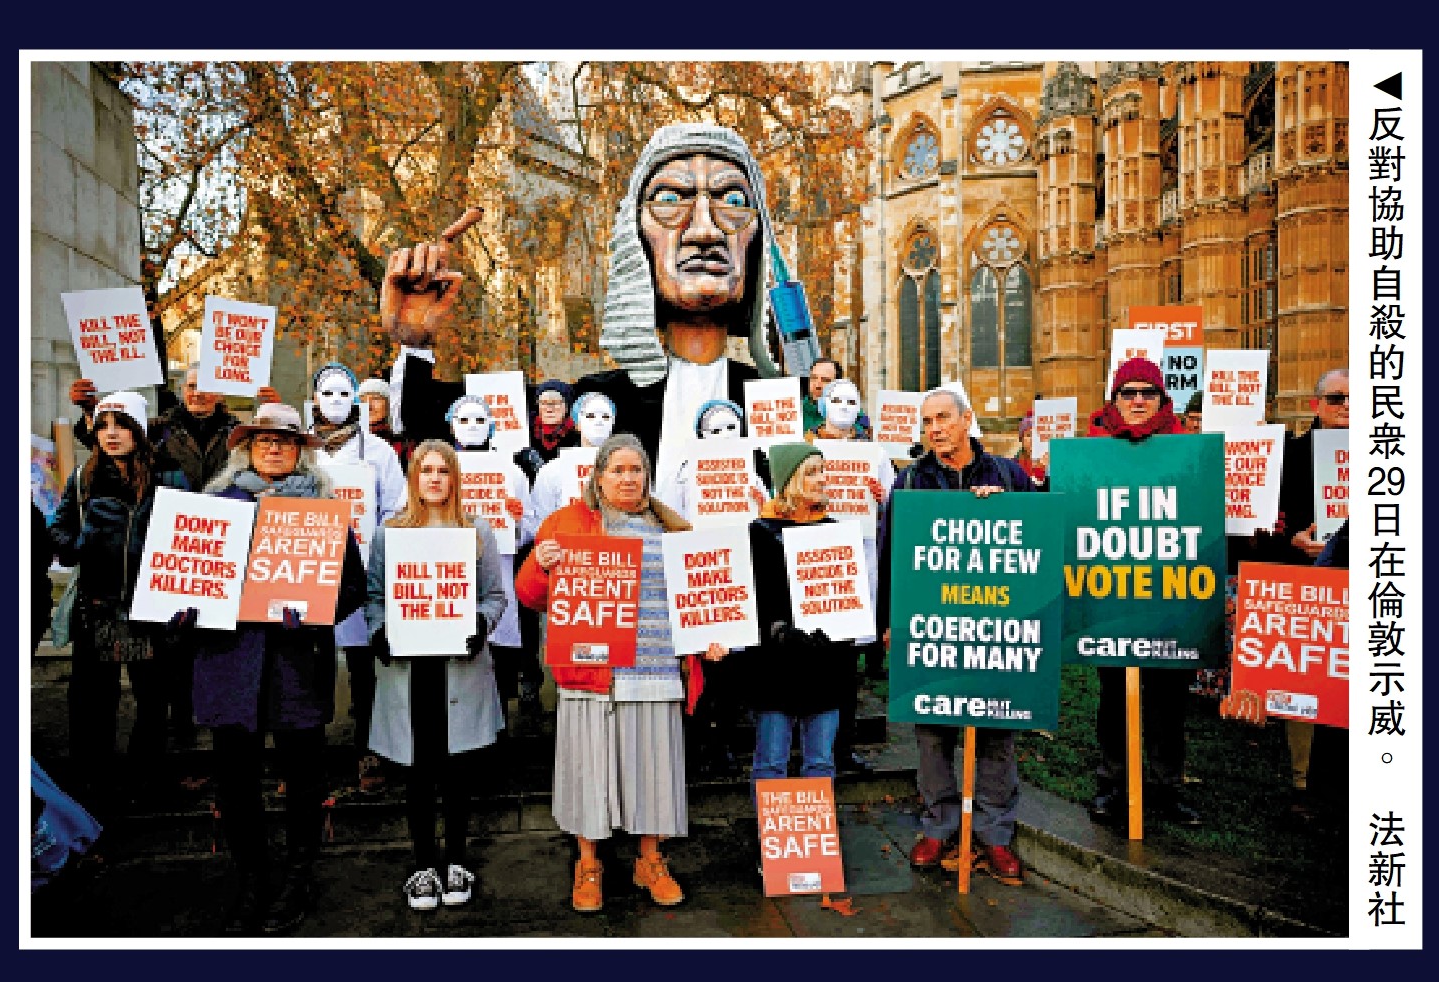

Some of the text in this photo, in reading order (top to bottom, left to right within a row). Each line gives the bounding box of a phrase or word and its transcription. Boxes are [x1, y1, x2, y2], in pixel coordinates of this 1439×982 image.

[79, 313, 142, 333] KILL THE
[227, 313, 270, 332] WON'T
[119, 328, 146, 344] NOT
[215, 326, 263, 343] BE OUR
[90, 348, 119, 364] THE
[213, 339, 262, 358] CHOICE
[222, 355, 250, 367] FOR
[1168, 356, 1198, 371] NO
[1165, 373, 1198, 391] RM
[1234, 457, 1268, 472] OUR
[1225, 473, 1266, 487] OICE
[1097, 486, 1178, 520] IF IN
[173, 512, 232, 537] DON'T
[264, 510, 300, 526] THE
[303, 511, 343, 529] BILL
[930, 518, 1023, 545] CHOICE
[171, 533, 227, 557] MAKE
[256, 538, 343, 557] ARENT
[1076, 526, 1202, 561] DOUBT
[150, 551, 237, 580] DOCTORS
[560, 548, 637, 567] THE BILL
[683, 548, 733, 570] DON'T
[797, 546, 855, 566] ASSISTED
[913, 545, 1043, 574] FOR A FEW
[249, 557, 339, 586] SAFE
[395, 562, 466, 580] KILL THE
[687, 567, 733, 588] MAKE
[797, 562, 859, 583] SUICIDE IS
[149, 573, 229, 599] KILLERS.
[393, 582, 471, 601] BILL, NOT
[554, 577, 637, 599] ARENT
[804, 580, 856, 599] NOT THE
[1063, 565, 1216, 600] VOTE NO
[1246, 579, 1293, 600] THE
[675, 585, 749, 609] DOCTORS
[940, 583, 1010, 607] MEANS
[398, 601, 432, 620] THE
[551, 600, 637, 629] SAFE
[909, 614, 1042, 644] COERCION
[1077, 635, 1151, 657] care
[907, 642, 1043, 673] FOR MANY
[1237, 637, 1349, 680] SAFE
[913, 693, 986, 717] care
[761, 790, 830, 806] THE BILL
[762, 813, 834, 834] ARENT
[763, 833, 840, 860] SAFE
